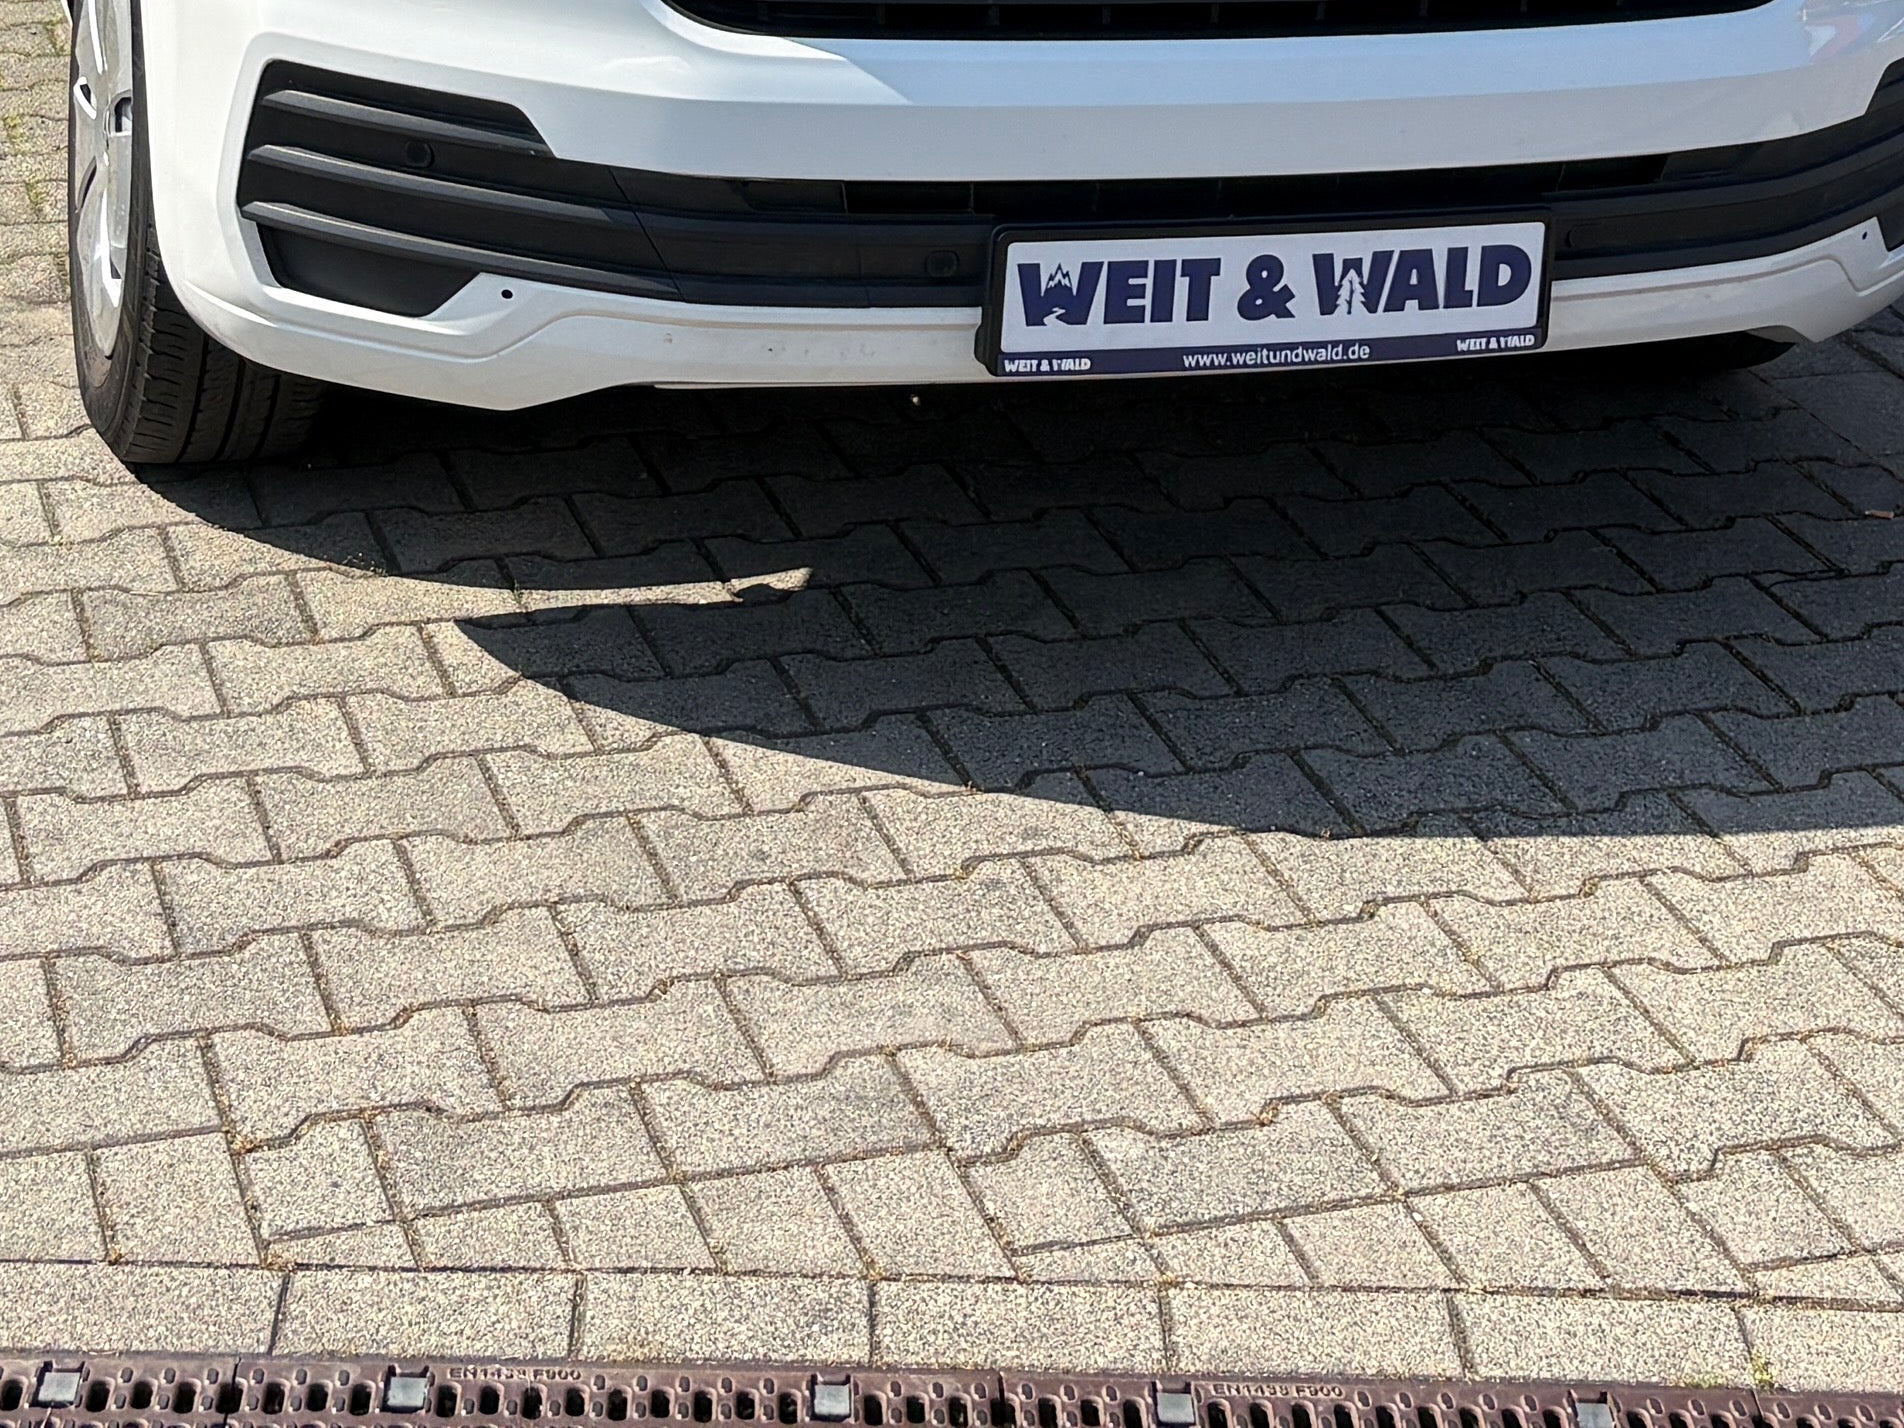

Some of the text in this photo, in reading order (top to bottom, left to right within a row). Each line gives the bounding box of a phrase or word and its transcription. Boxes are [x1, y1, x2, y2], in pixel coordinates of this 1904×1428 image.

[1016, 244, 1532, 327] WEIT & WALD
[1004, 359, 1039, 373] WEIT
[1183, 342, 1371, 368] www.weitundwald.de
